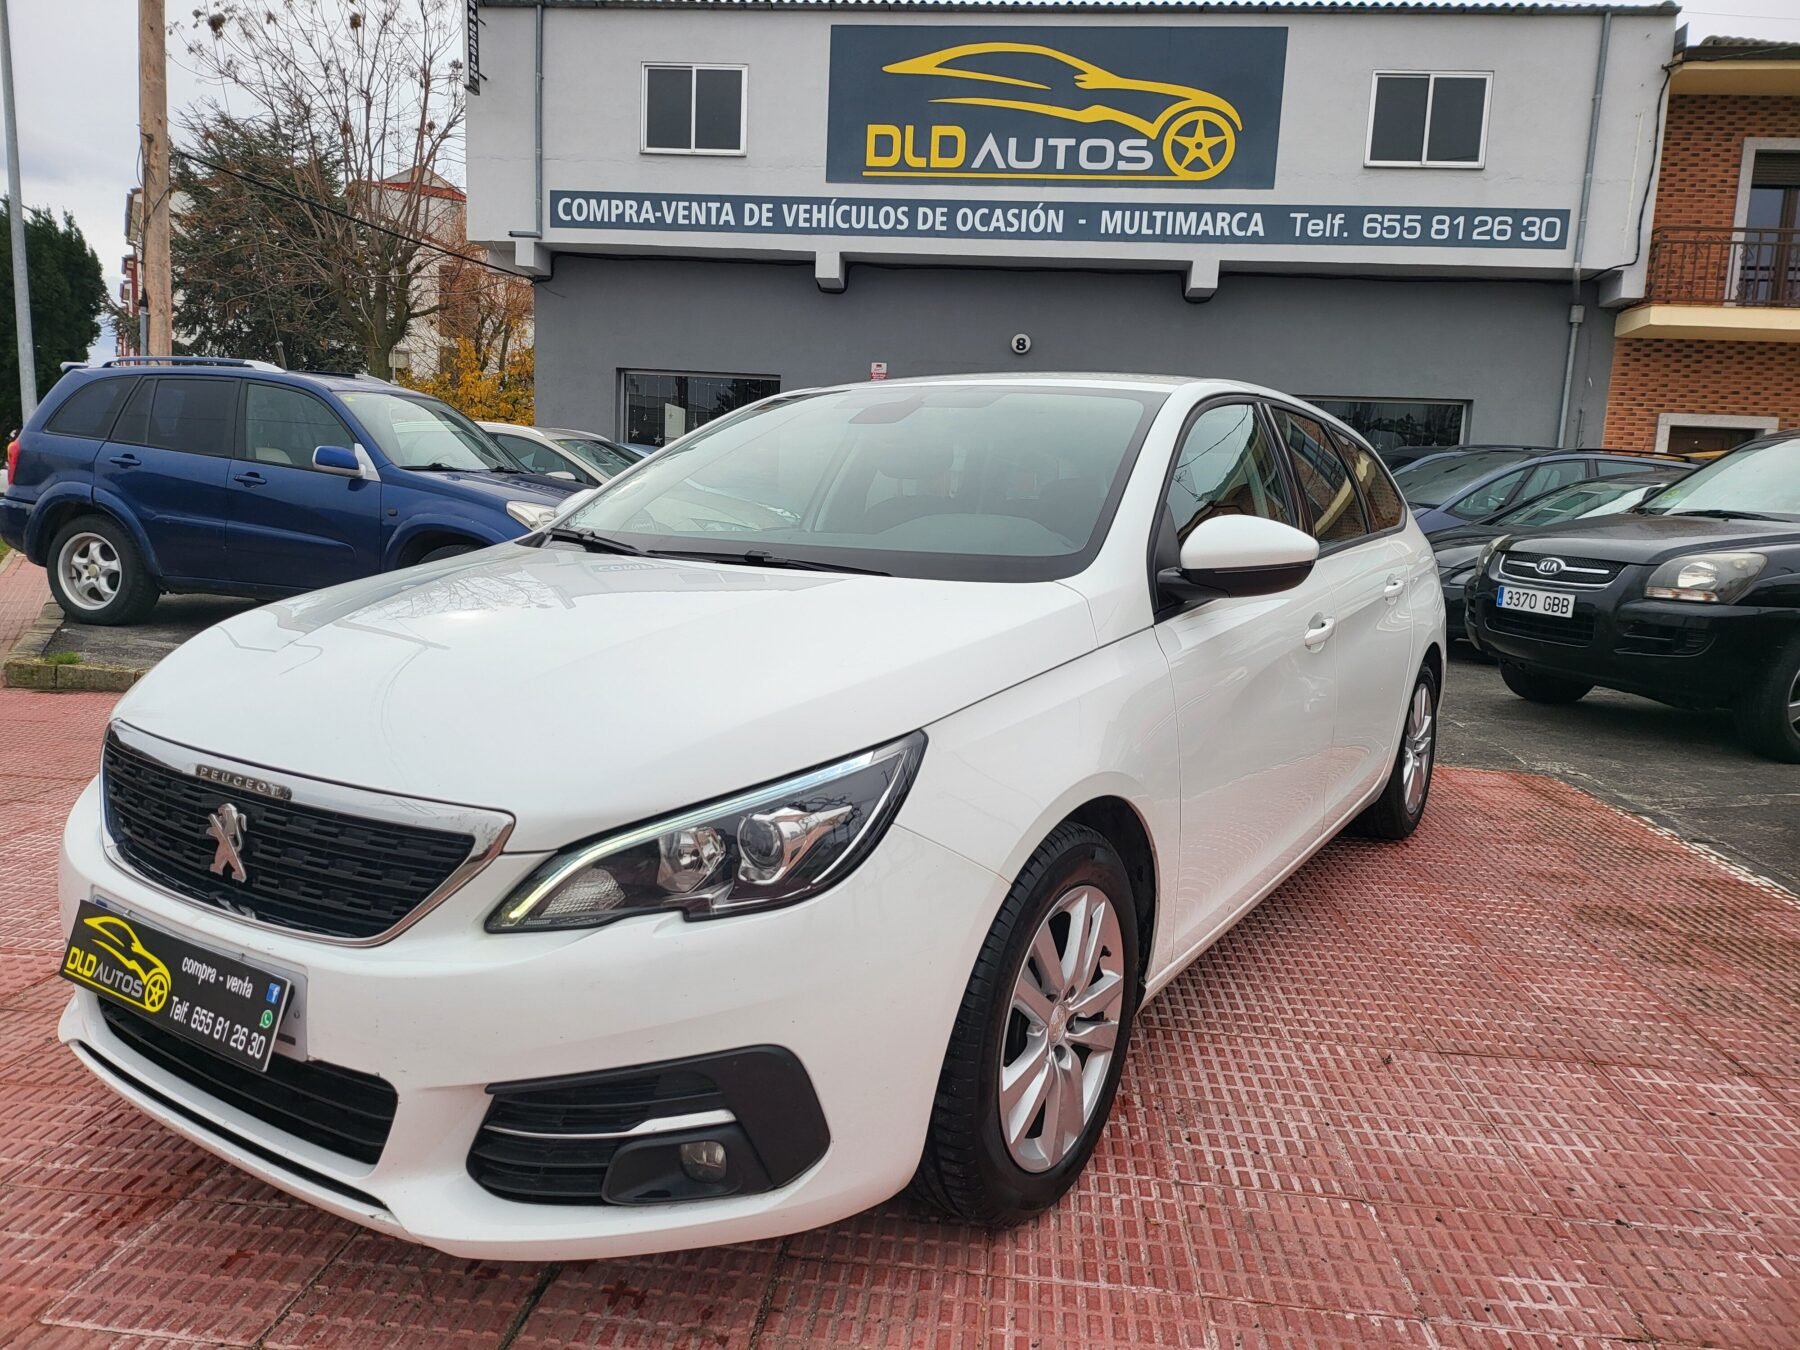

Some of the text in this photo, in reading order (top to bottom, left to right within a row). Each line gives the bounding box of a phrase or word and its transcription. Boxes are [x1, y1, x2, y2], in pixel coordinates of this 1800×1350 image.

[865, 124, 1154, 171] DLD AUTOS
[557, 197, 736, 226] COMPRA-VENTA
[743, 203, 774, 227] DE
[782, 199, 909, 230] VEHÍCULOS
[917, 207, 948, 231] DE
[956, 203, 1064, 233] OCASIÓN
[1100, 210, 1265, 237] MULTIMARCA
[1290, 212, 1349, 238] Telf.
[1362, 214, 1422, 240] 655
[1430, 215, 1465, 240] 81
[1472, 216, 1513, 241] 26
[1520, 217, 1562, 242] 30
[1016, 337, 1027, 351] 8
[1539, 561, 1558, 572] KIA
[1506, 590, 1570, 615] 3370 GBB
[199, 766, 281, 798] PEUGEOT
[66, 946, 143, 998] DLD AUTOS
[182, 956, 217, 985] compra
[226, 973, 254, 999] venta
[169, 996, 266, 1060] Telf. 655 81 26 30
